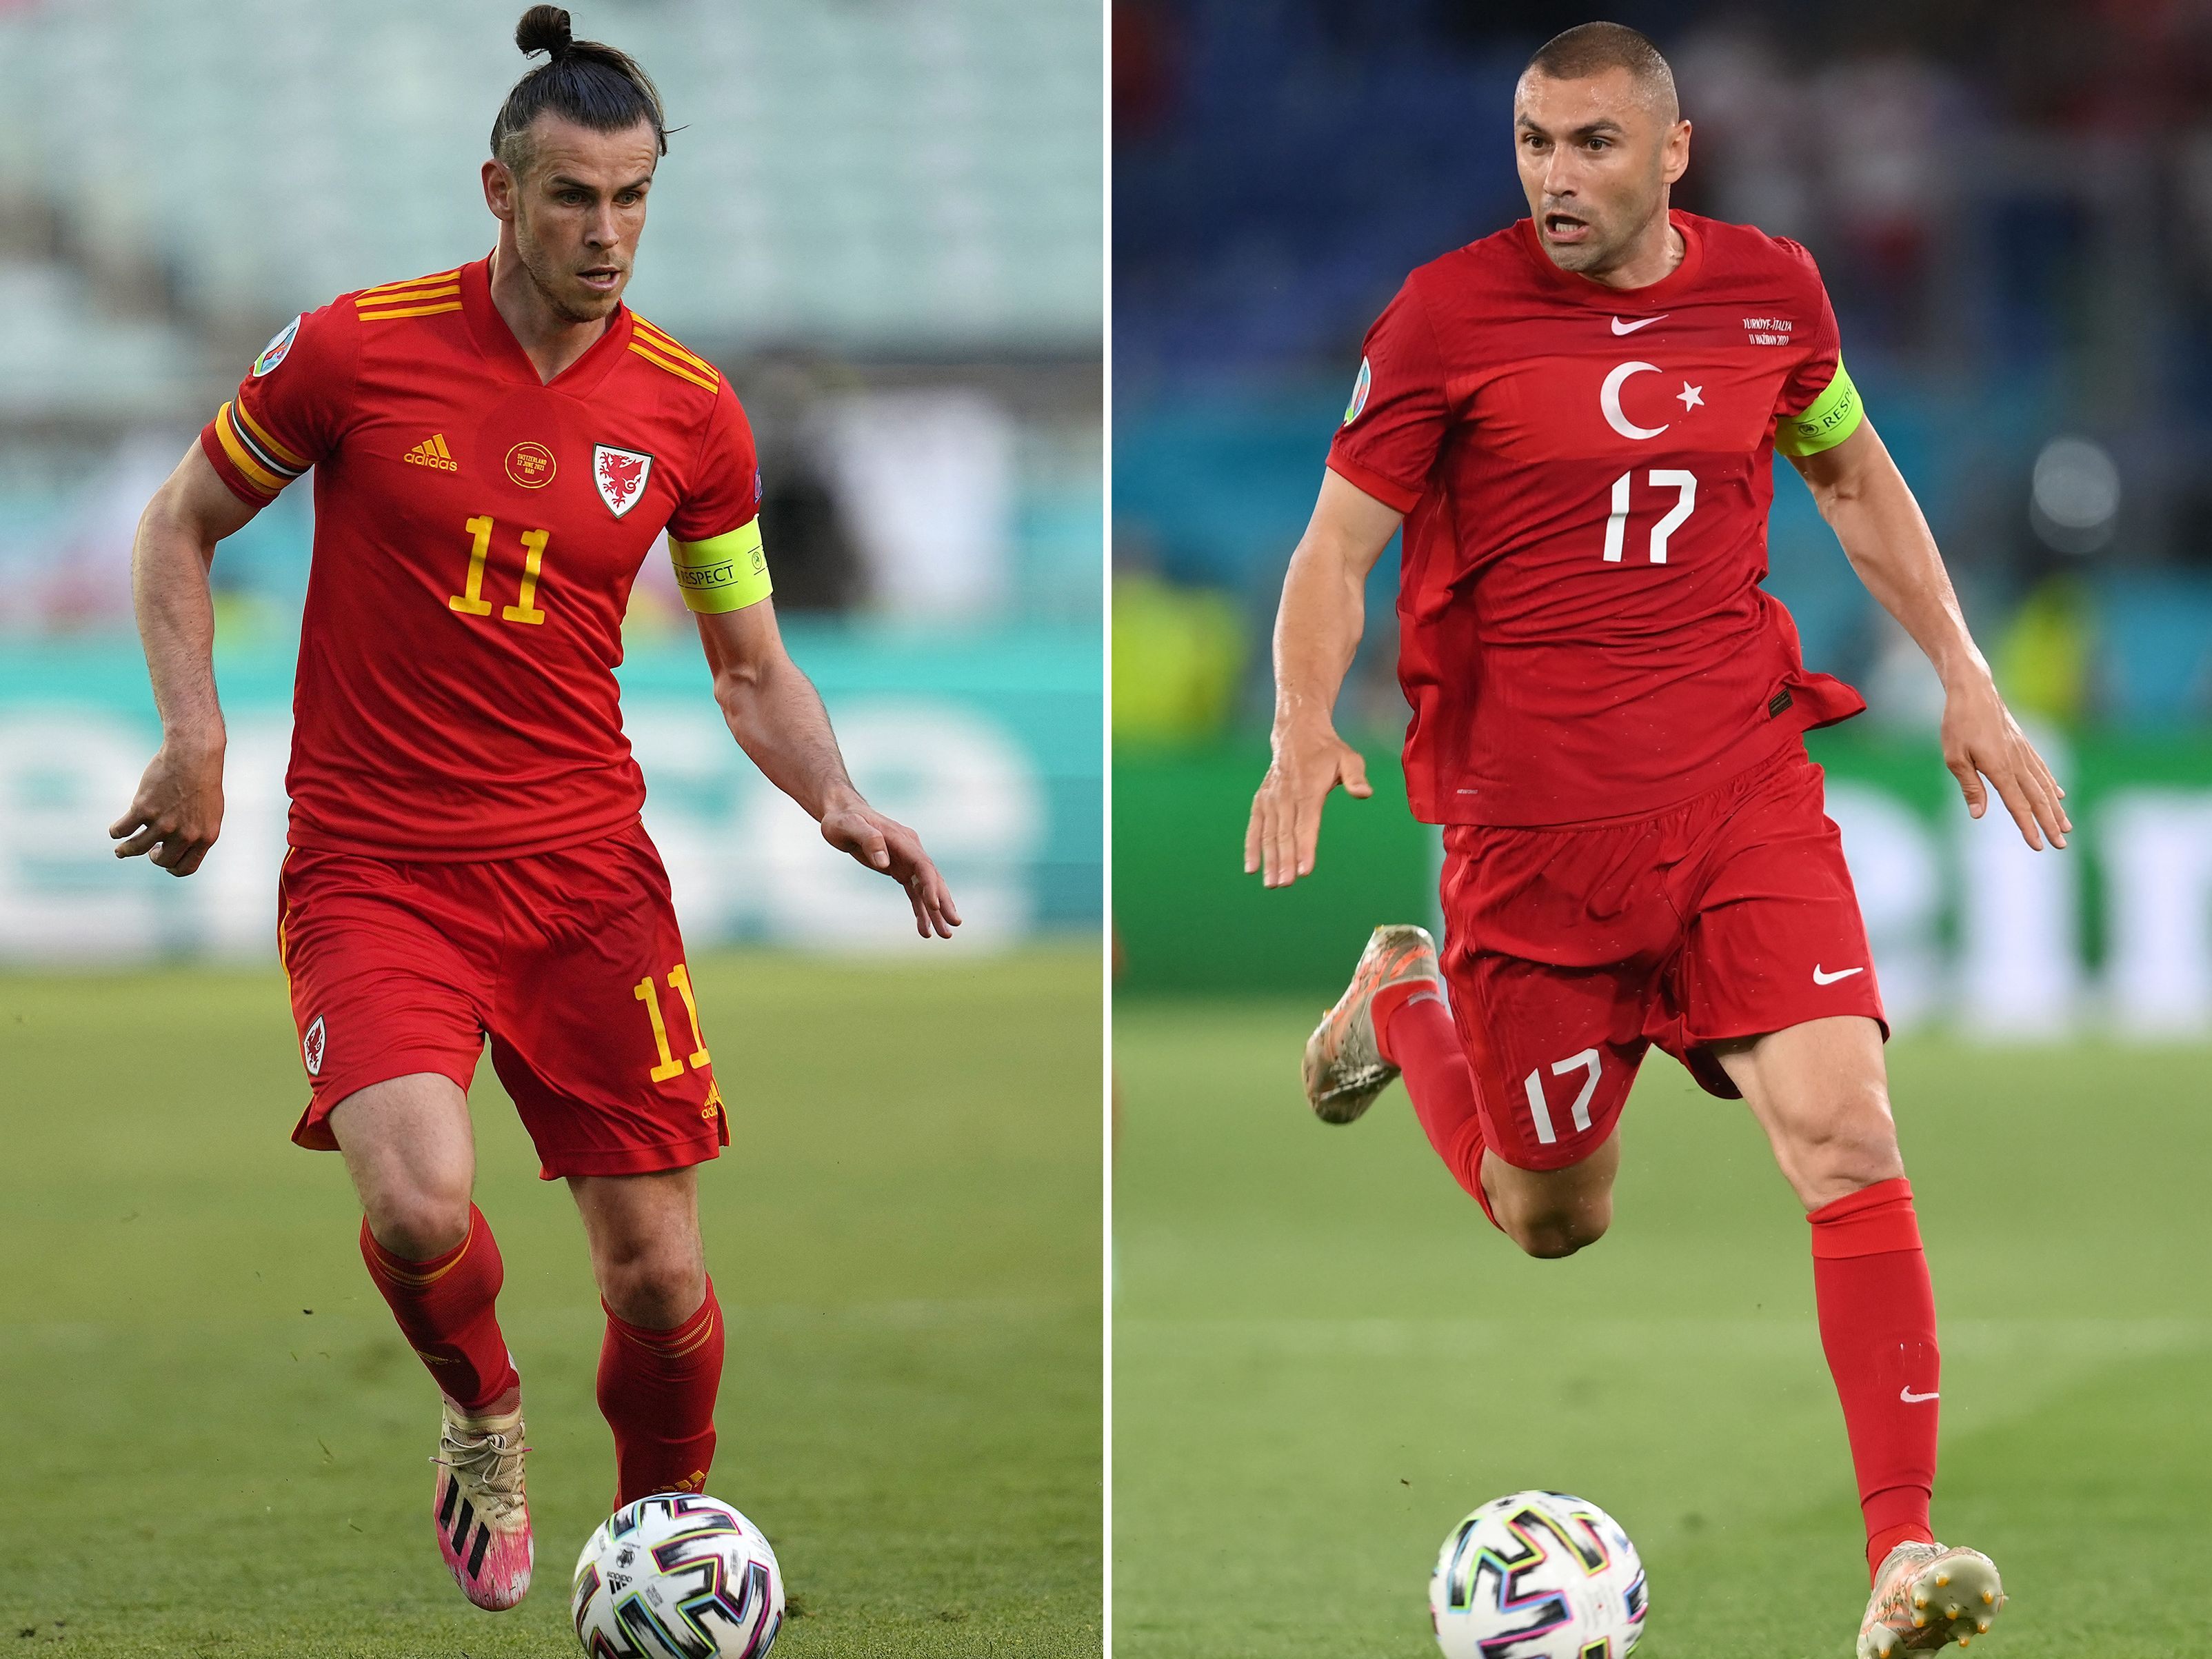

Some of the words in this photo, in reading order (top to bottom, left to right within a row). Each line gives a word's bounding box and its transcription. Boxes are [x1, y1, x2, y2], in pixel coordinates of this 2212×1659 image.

[403, 452, 458, 472] adidas
[517, 453, 547, 465] SWITZERLAND
[522, 461, 534, 469] JUNE
[1603, 469, 1698, 564] 17
[449, 515, 550, 625] 11
[681, 565, 733, 585] RESPECT
[634, 963, 711, 1083] 11
[1524, 1048, 1602, 1144] 17
